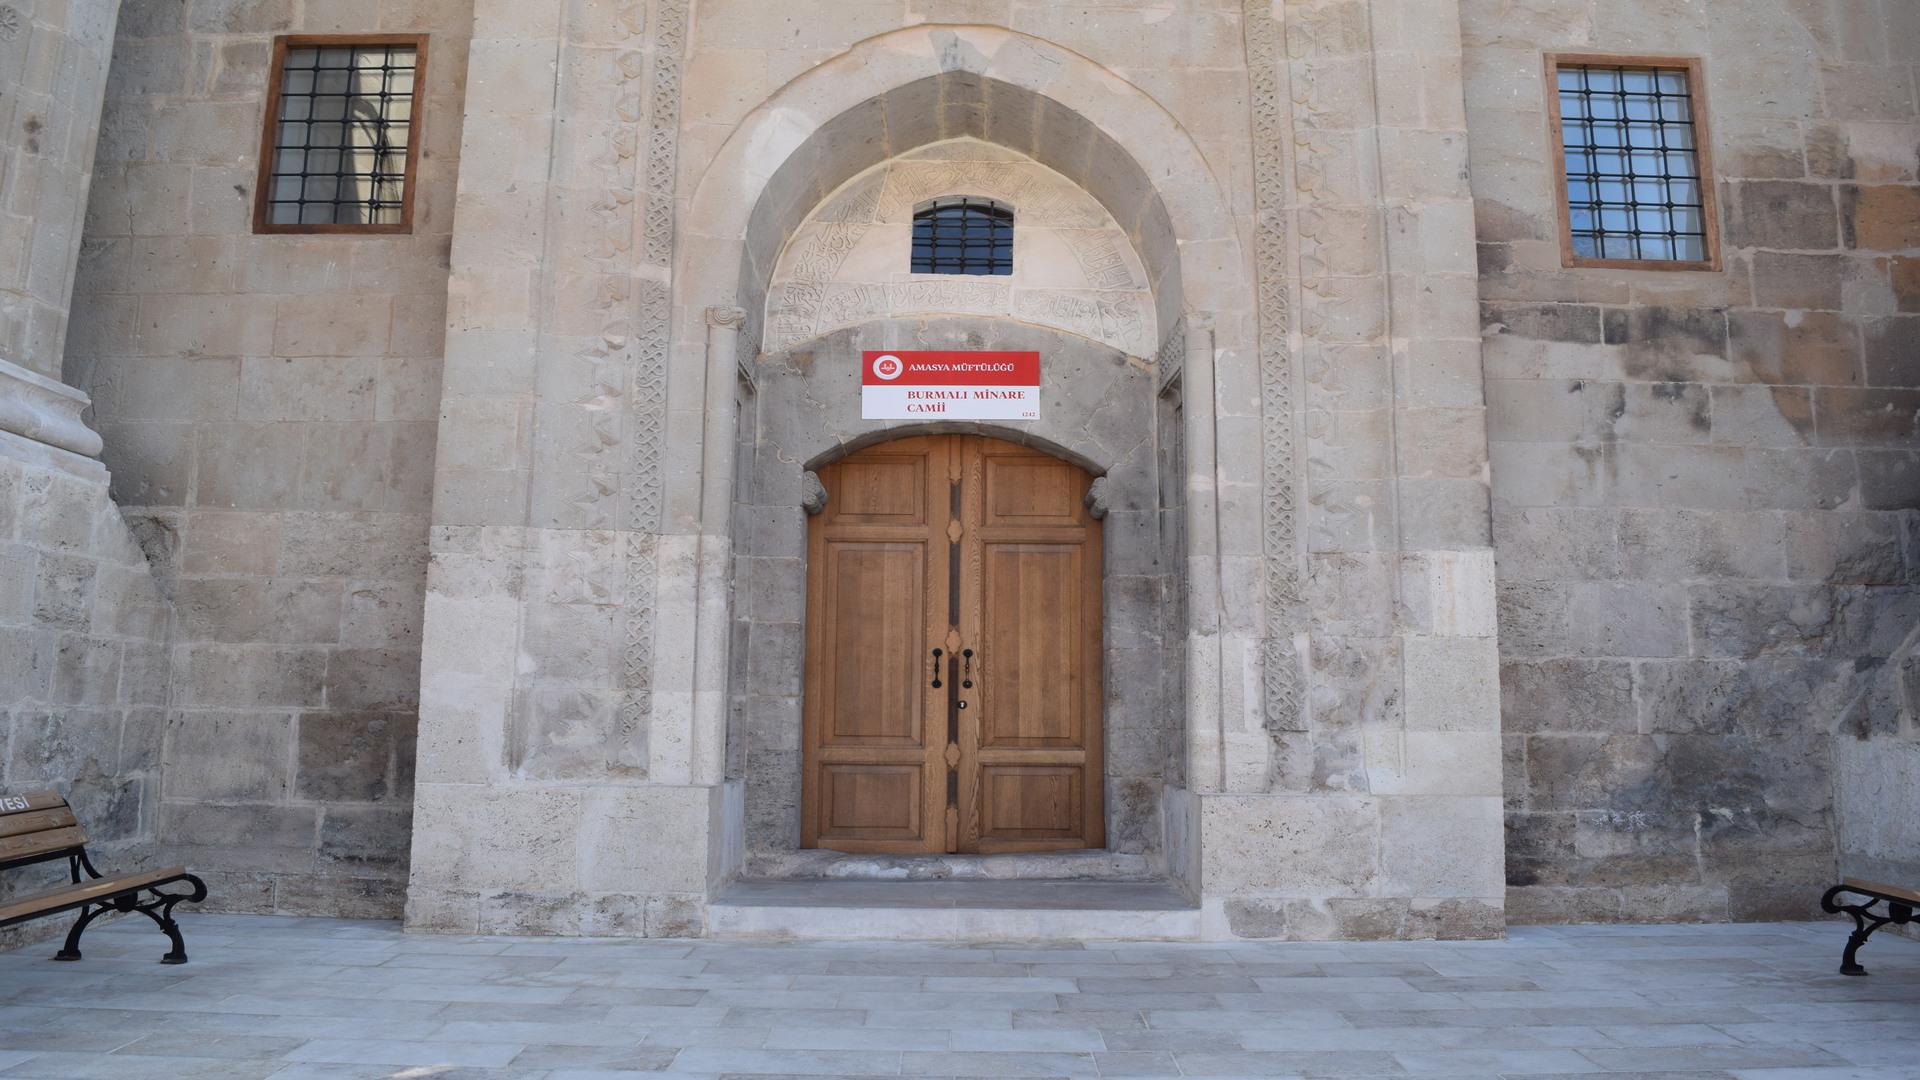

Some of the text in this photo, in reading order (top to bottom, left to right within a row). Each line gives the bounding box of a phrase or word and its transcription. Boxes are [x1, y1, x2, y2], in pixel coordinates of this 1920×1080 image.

[952, 363, 1015, 371] MÜFTÜLÜĞÜ
[907, 389, 1025, 399] BURMALI MİNARE
[907, 402, 946, 412] CAMİİ
